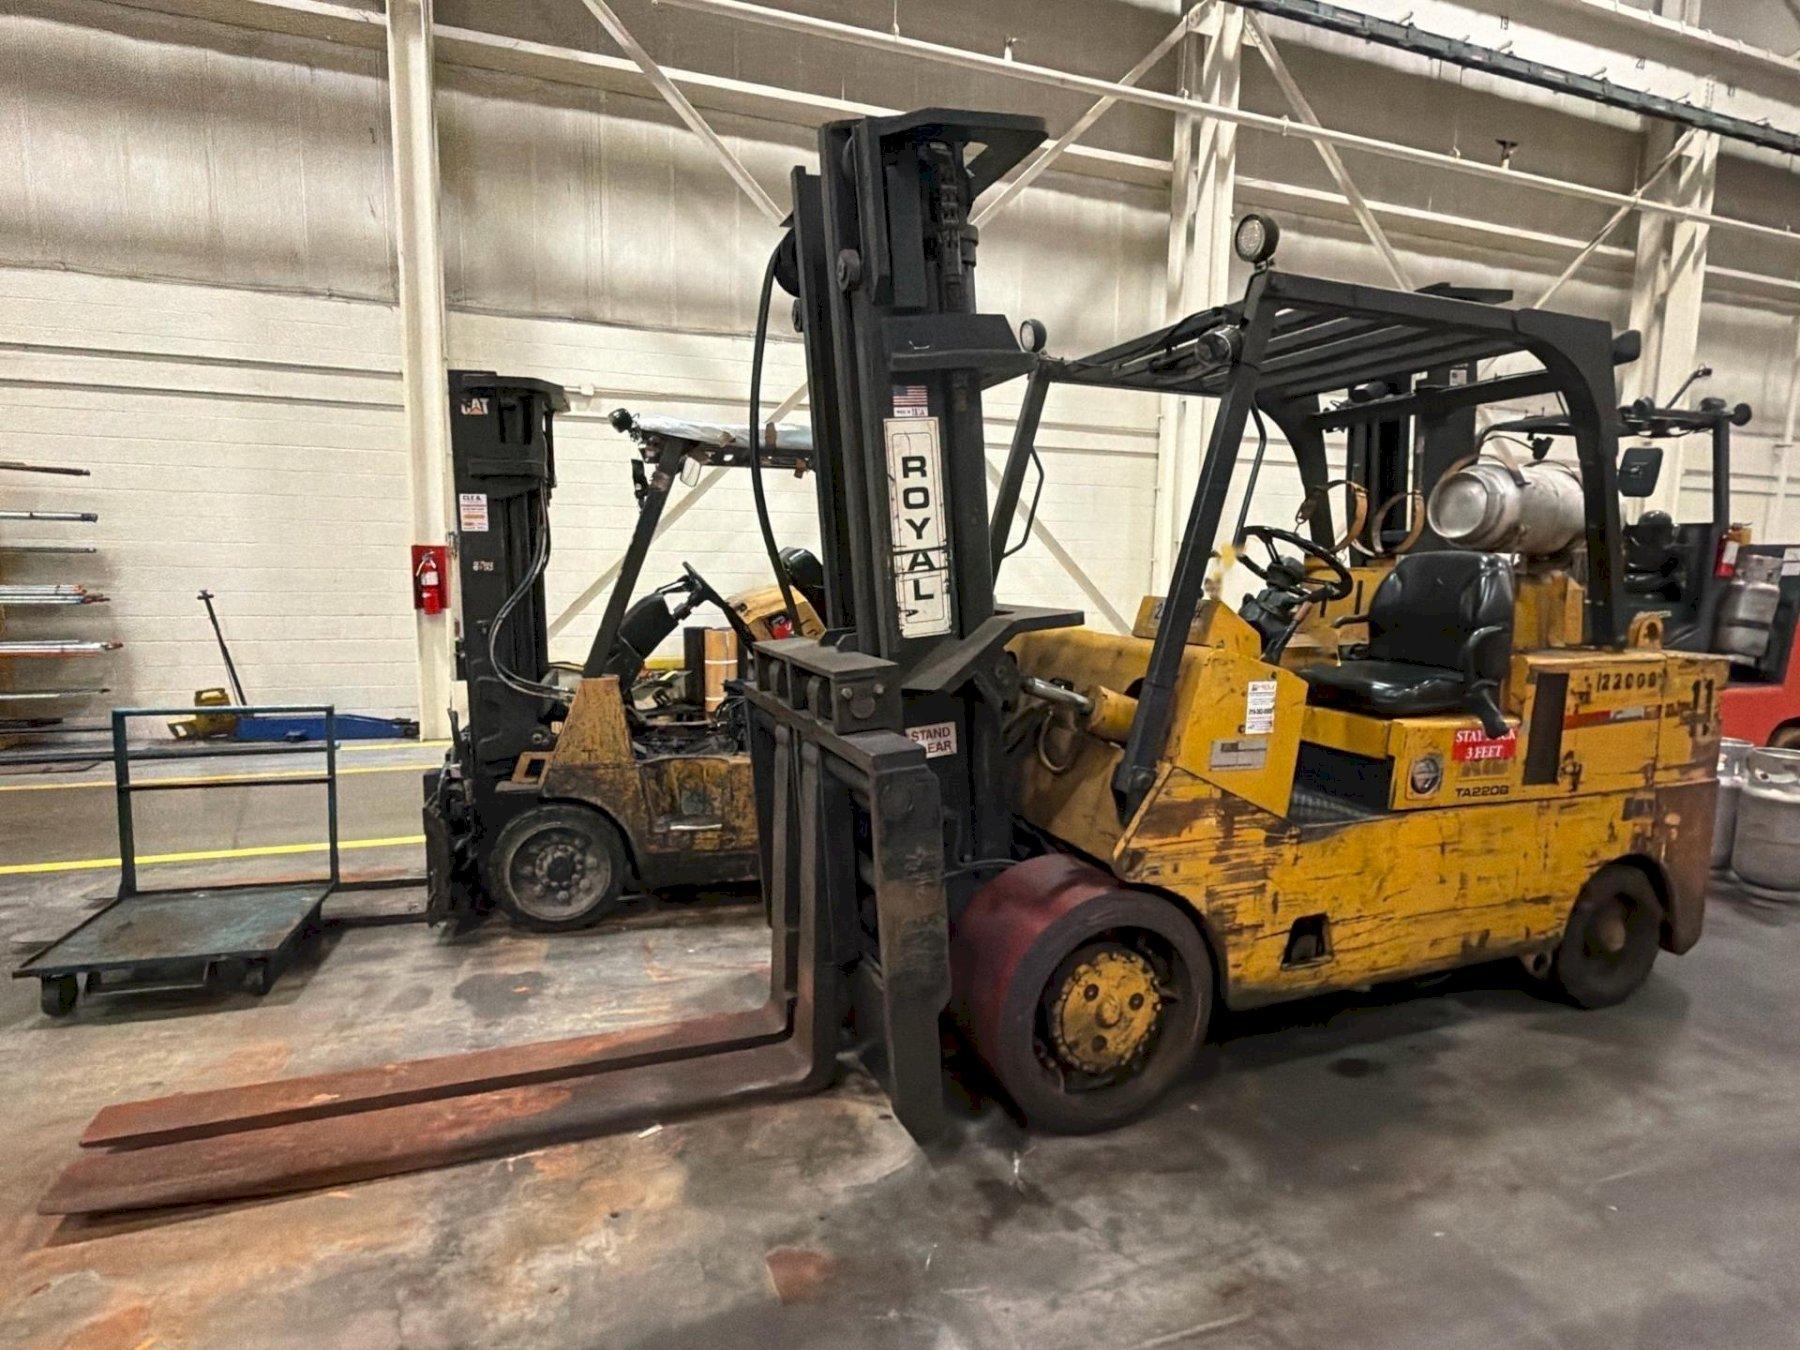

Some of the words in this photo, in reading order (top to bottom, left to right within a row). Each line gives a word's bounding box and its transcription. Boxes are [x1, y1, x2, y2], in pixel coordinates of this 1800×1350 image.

[461, 398, 489, 415] CAT
[901, 455, 936, 601] ROYAL
[910, 727, 951, 742] STAND
[927, 740, 954, 754] EAR
[1465, 746, 1473, 760] 3
[1473, 745, 1503, 759] FEET
